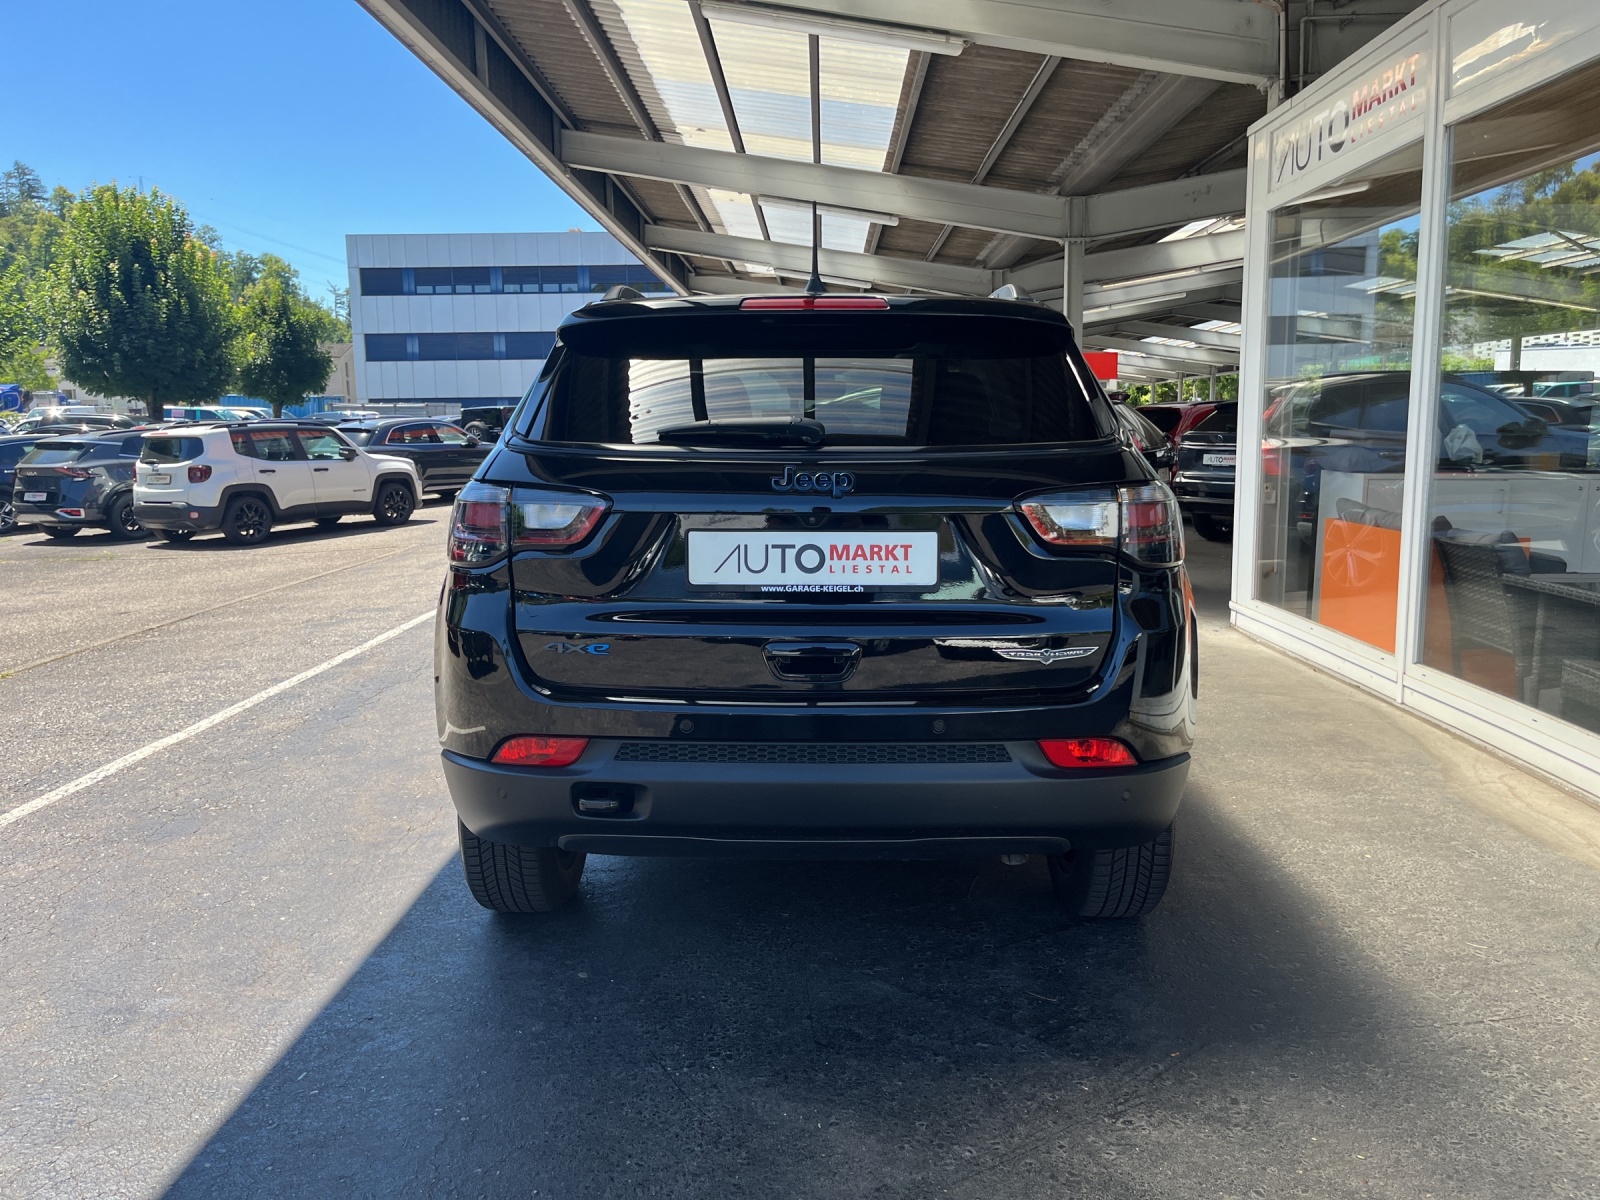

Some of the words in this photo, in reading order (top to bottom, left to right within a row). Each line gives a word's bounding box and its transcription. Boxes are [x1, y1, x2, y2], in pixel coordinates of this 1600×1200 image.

[1277, 99, 1350, 183] AUTO
[1351, 53, 1420, 121] MARKT
[1351, 94, 1418, 144] LIESTAL
[769, 465, 855, 498] Jeep
[714, 544, 826, 574] AUTO
[829, 544, 913, 562] MARKT
[829, 565, 913, 574] LIESTAL
[760, 585, 864, 593] www.GARAGE-KEIGEL.ch
